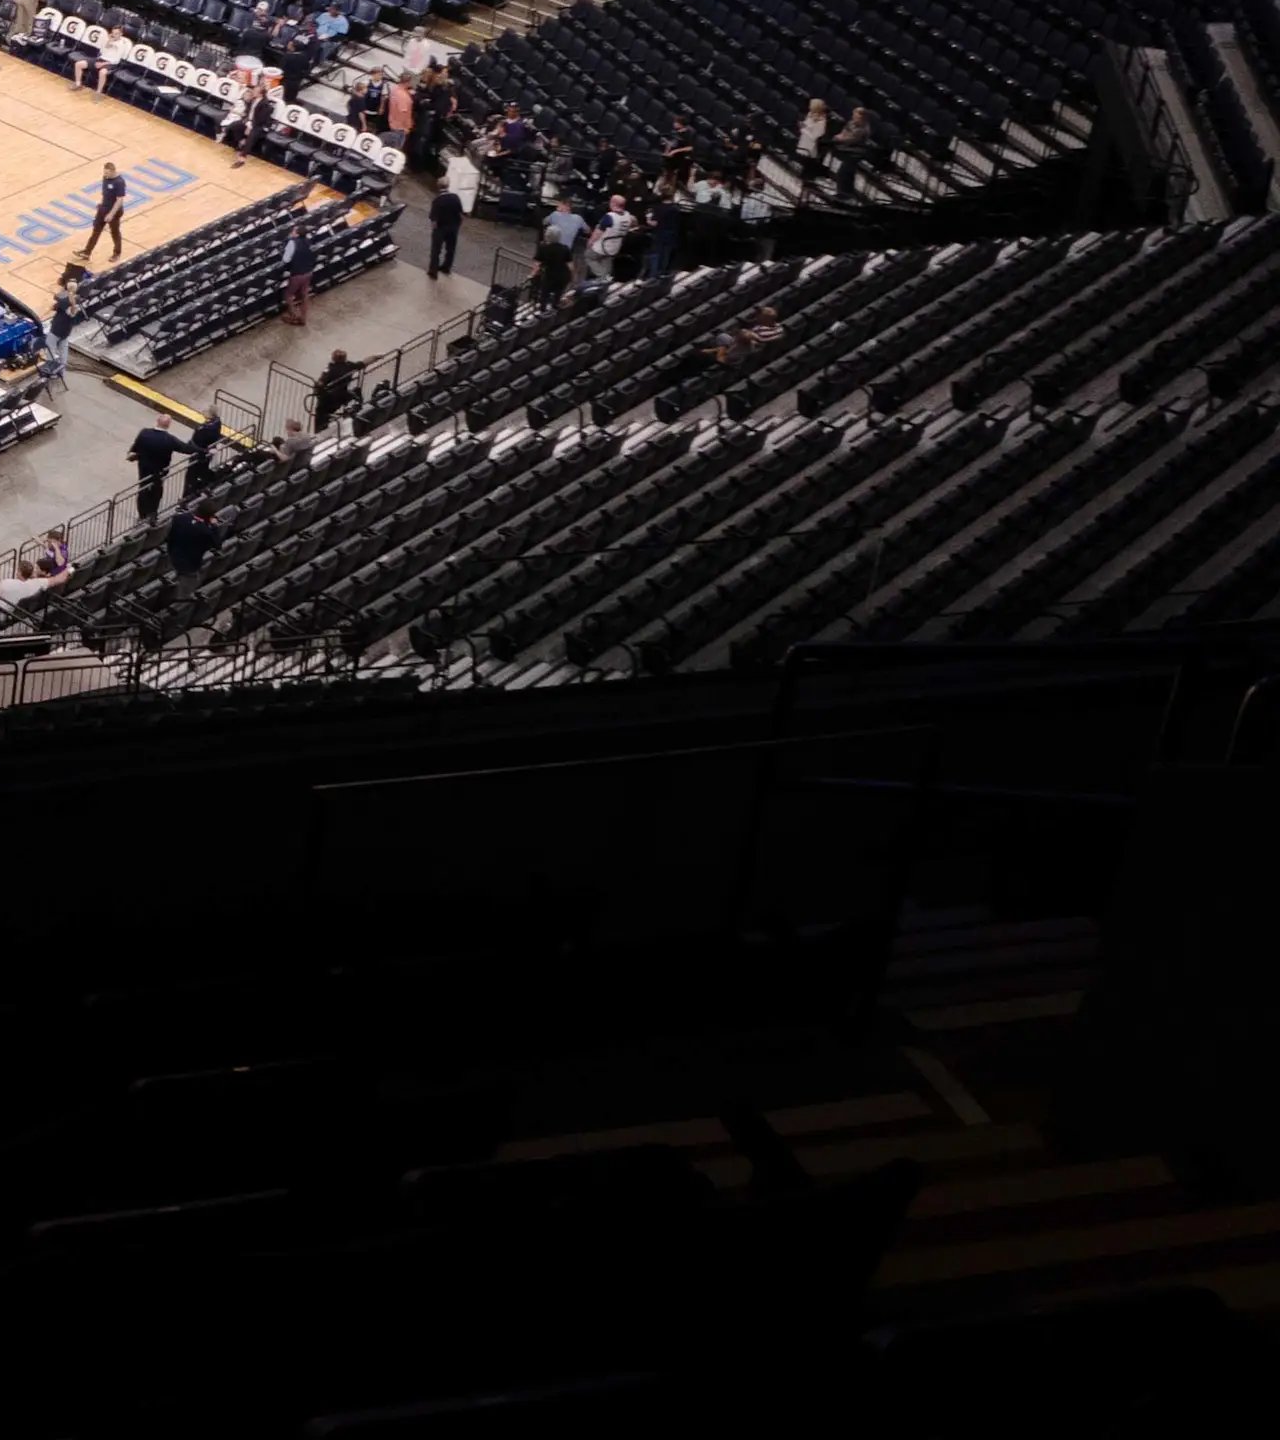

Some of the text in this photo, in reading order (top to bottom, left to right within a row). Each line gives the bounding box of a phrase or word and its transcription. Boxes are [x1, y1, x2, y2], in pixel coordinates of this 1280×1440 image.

[67, 22, 78, 33] G
[89, 30, 100, 42] G
[135, 49, 147, 61] G
[156, 57, 168, 70] G
[176, 66, 188, 78] G
[197, 74, 209, 86] G
[219, 82, 231, 95] G
[287, 110, 300, 123] G
[311, 119, 323, 133] G
[334, 128, 348, 142] G
[360, 138, 374, 152] G
[383, 152, 397, 167] G
